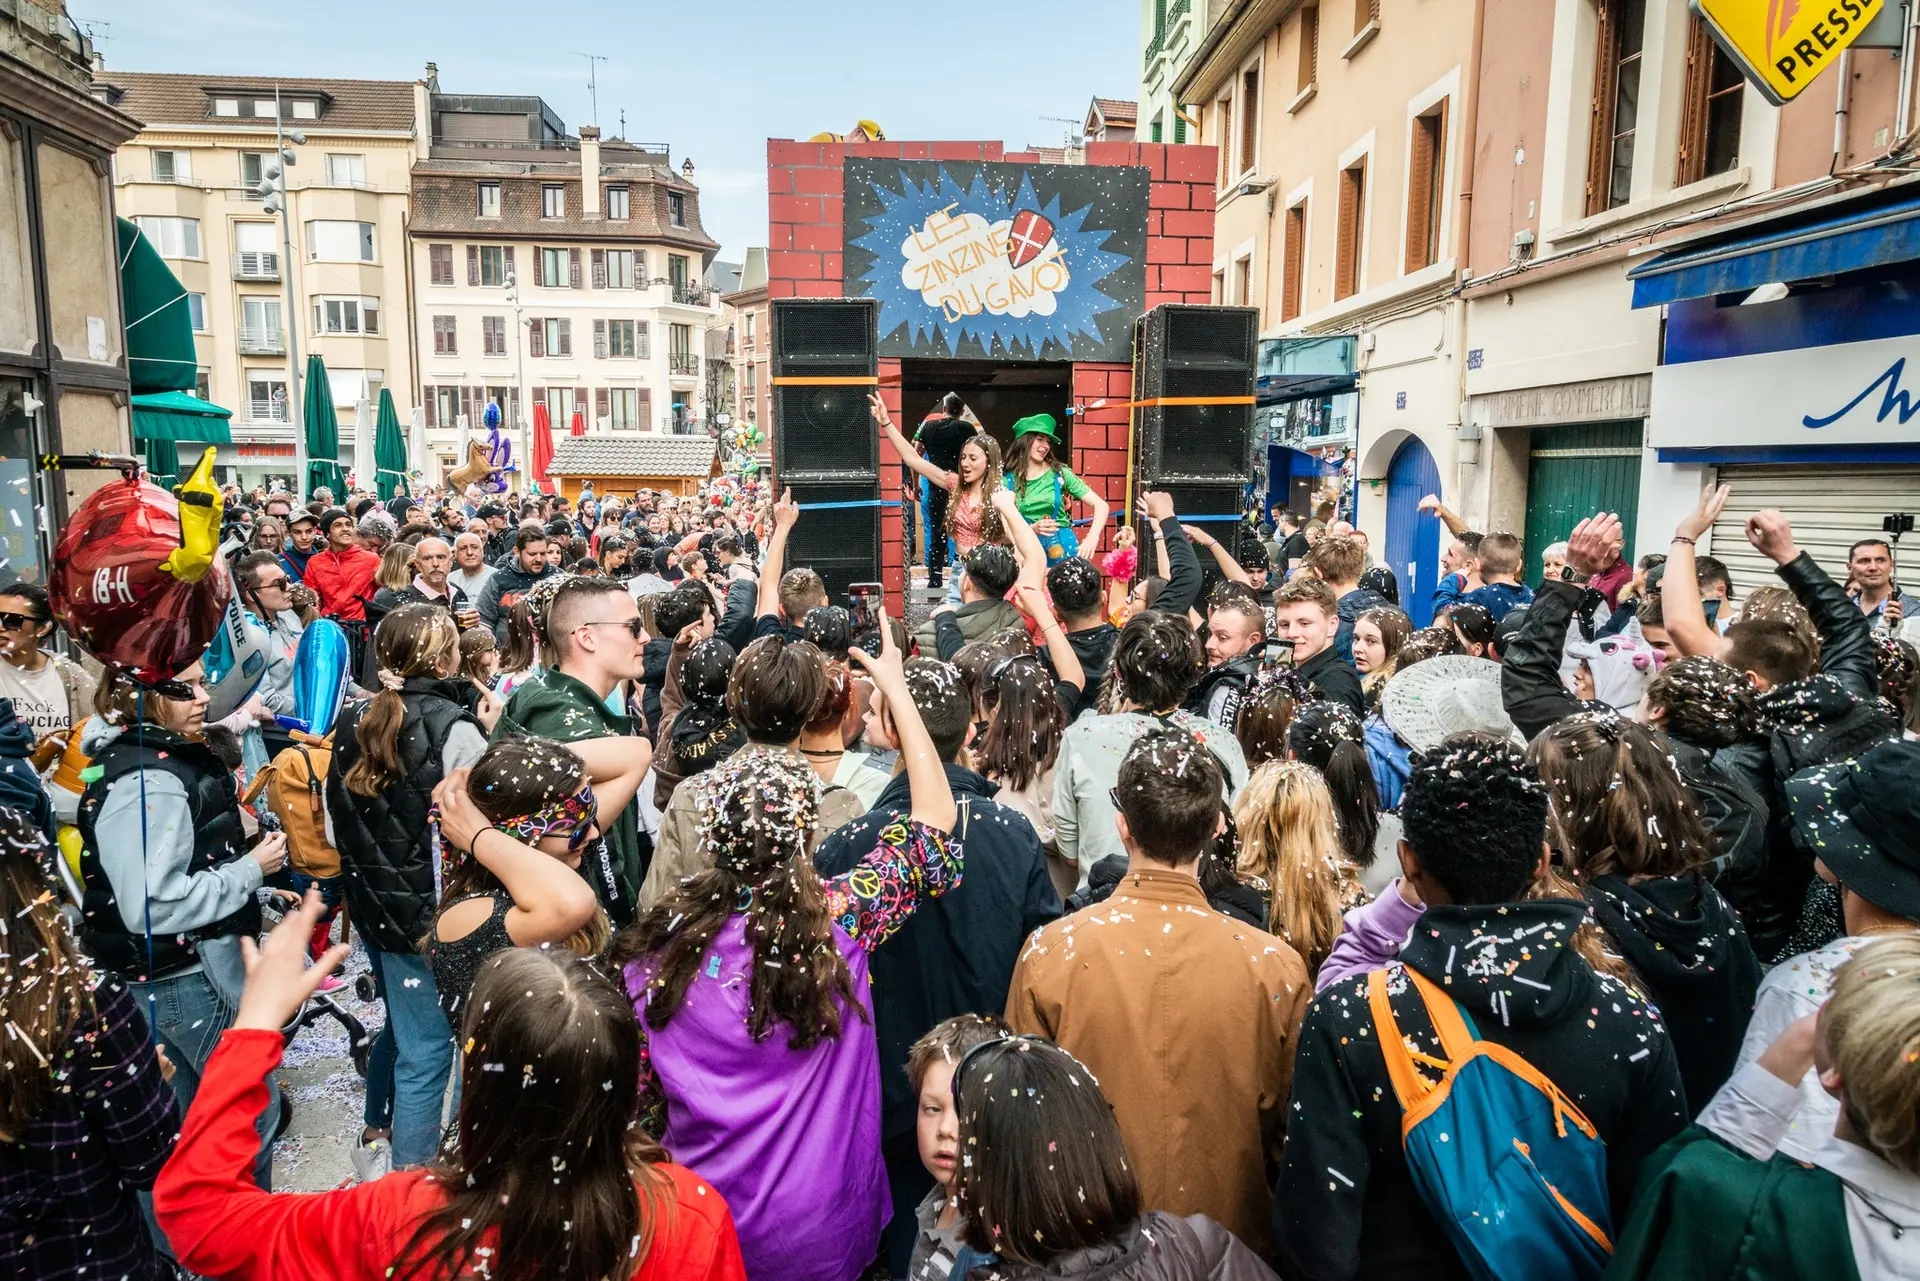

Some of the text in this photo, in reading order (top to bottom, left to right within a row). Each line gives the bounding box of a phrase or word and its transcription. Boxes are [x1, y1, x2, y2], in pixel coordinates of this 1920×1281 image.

[909, 202, 970, 252] LES
[914, 227, 1015, 292] ZINZINS
[939, 248, 1071, 324] DU GAVOT
[228, 456, 271, 465] only shoes
[229, 596, 247, 648] POLICE
[12, 697, 55, 713] Fxck
